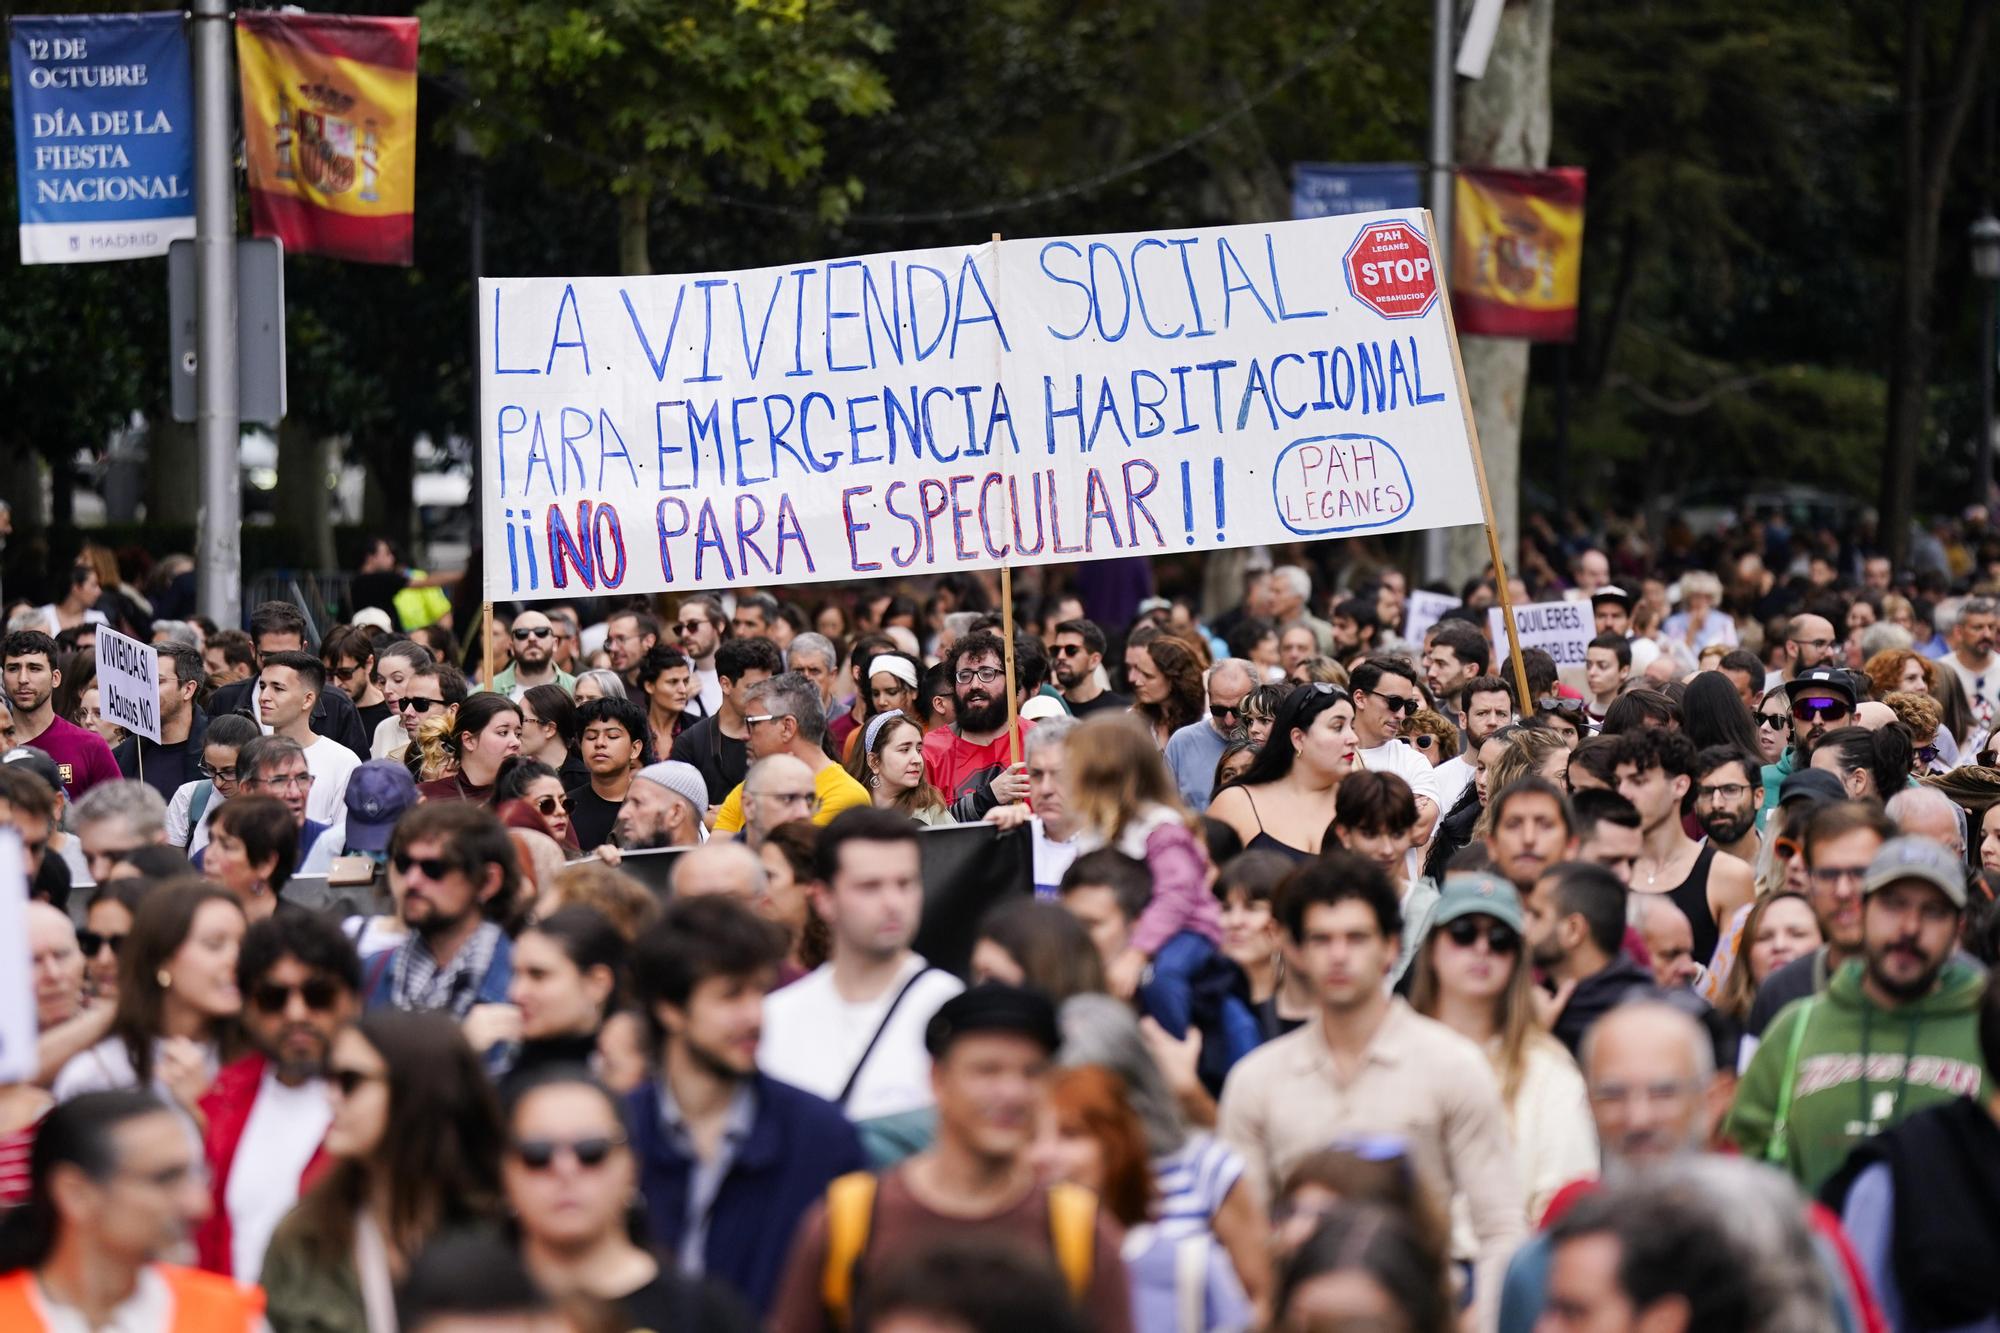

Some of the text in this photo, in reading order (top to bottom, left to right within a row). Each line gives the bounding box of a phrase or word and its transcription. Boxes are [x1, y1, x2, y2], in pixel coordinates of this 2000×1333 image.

[29, 38, 87, 60] 12 DE
[29, 64, 148, 89] OCTUBRE
[33, 108, 173, 137] DÍA DE LA
[35, 144, 131, 170] FIESTA
[37, 175, 189, 203] NACIONAL
[90, 234, 158, 249] MADRID
[1375, 231, 1402, 242] PAH
[1361, 258, 1431, 286] STOP
[494, 233, 1328, 383] LA VIVIENDA SOCIAL
[1376, 292, 1425, 303] DESAHUCIOS
[498, 335, 1445, 498] PARA EMERGENCIA HABITACIONAL
[1298, 441, 1377, 487] PAH
[1285, 485, 1404, 521] LEGANES
[656, 492, 816, 583] PARA
[101, 632, 141, 680] VIVIENDA
[109, 684, 138, 727] Abusos
